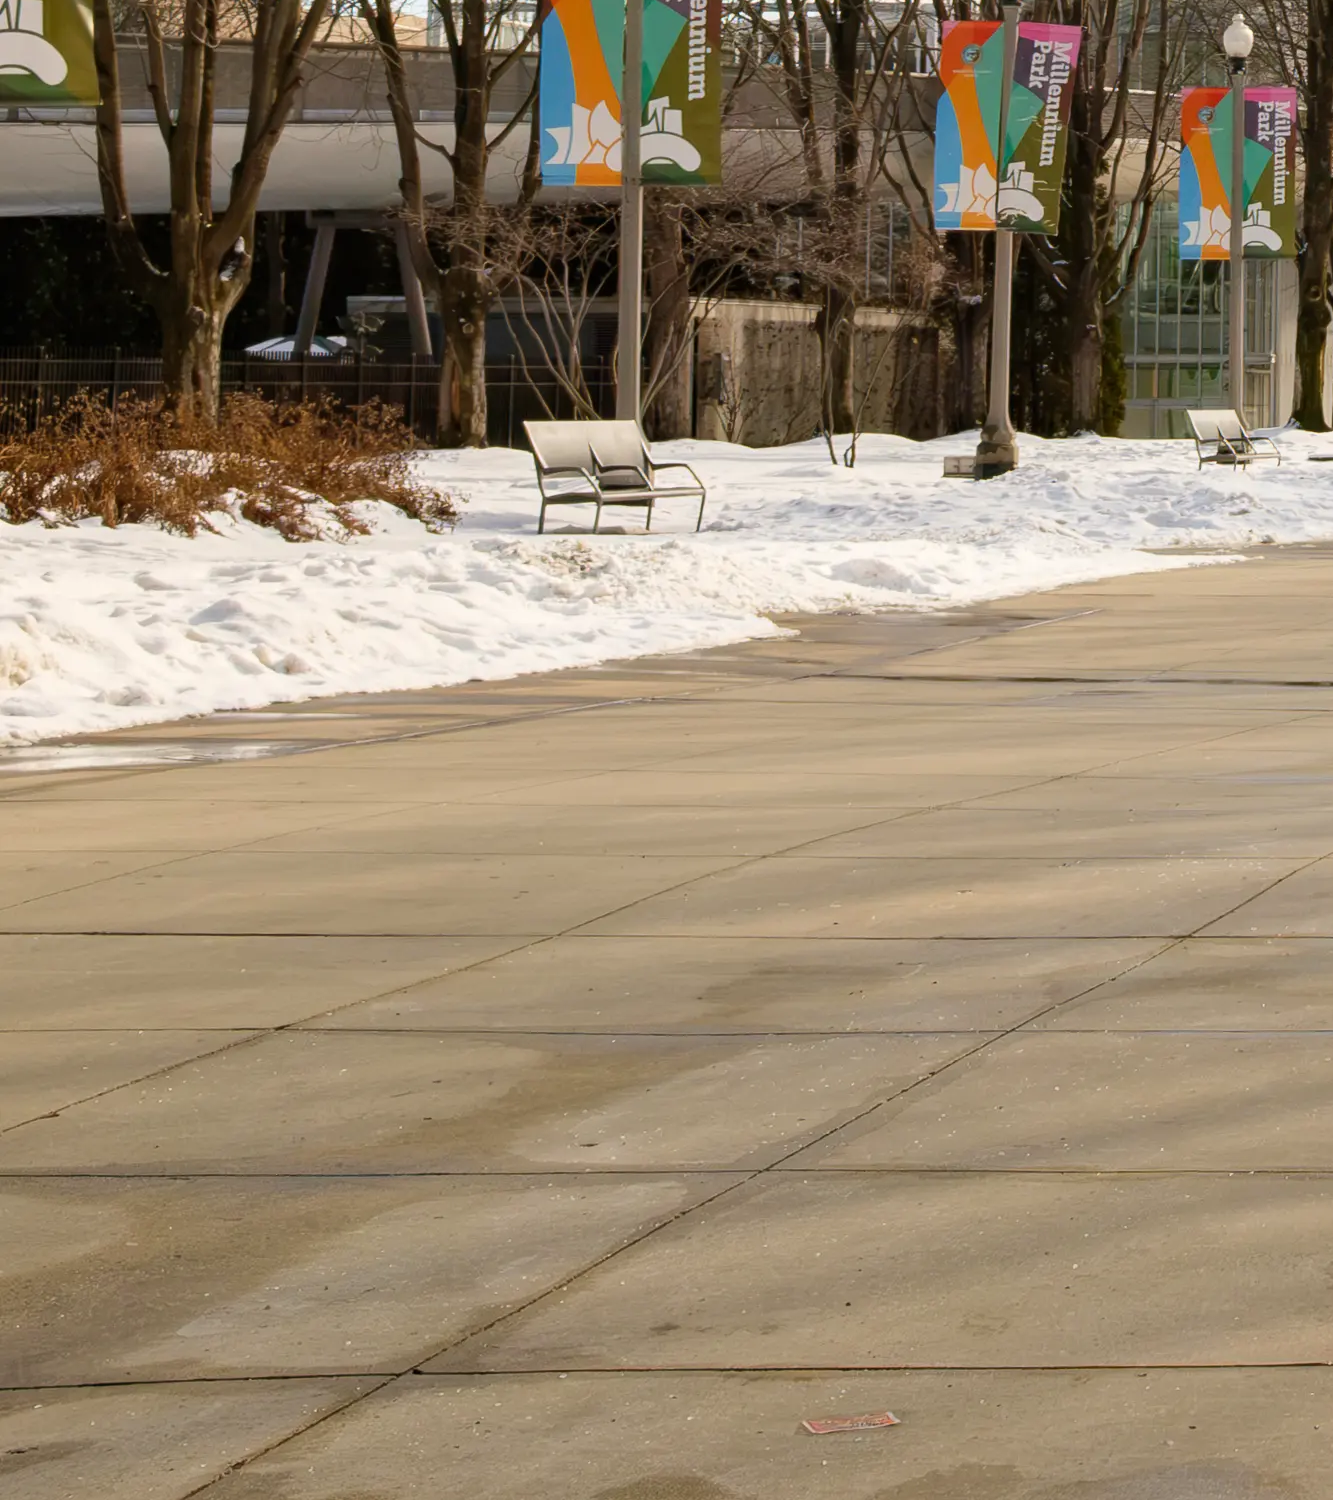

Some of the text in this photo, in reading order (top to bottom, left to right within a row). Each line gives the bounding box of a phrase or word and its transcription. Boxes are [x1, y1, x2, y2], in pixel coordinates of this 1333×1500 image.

[1028, 40, 1052, 89] Park
[1039, 42, 1073, 166] Millennium
[1257, 101, 1274, 142] Park
[1274, 102, 1291, 205] Millennium
